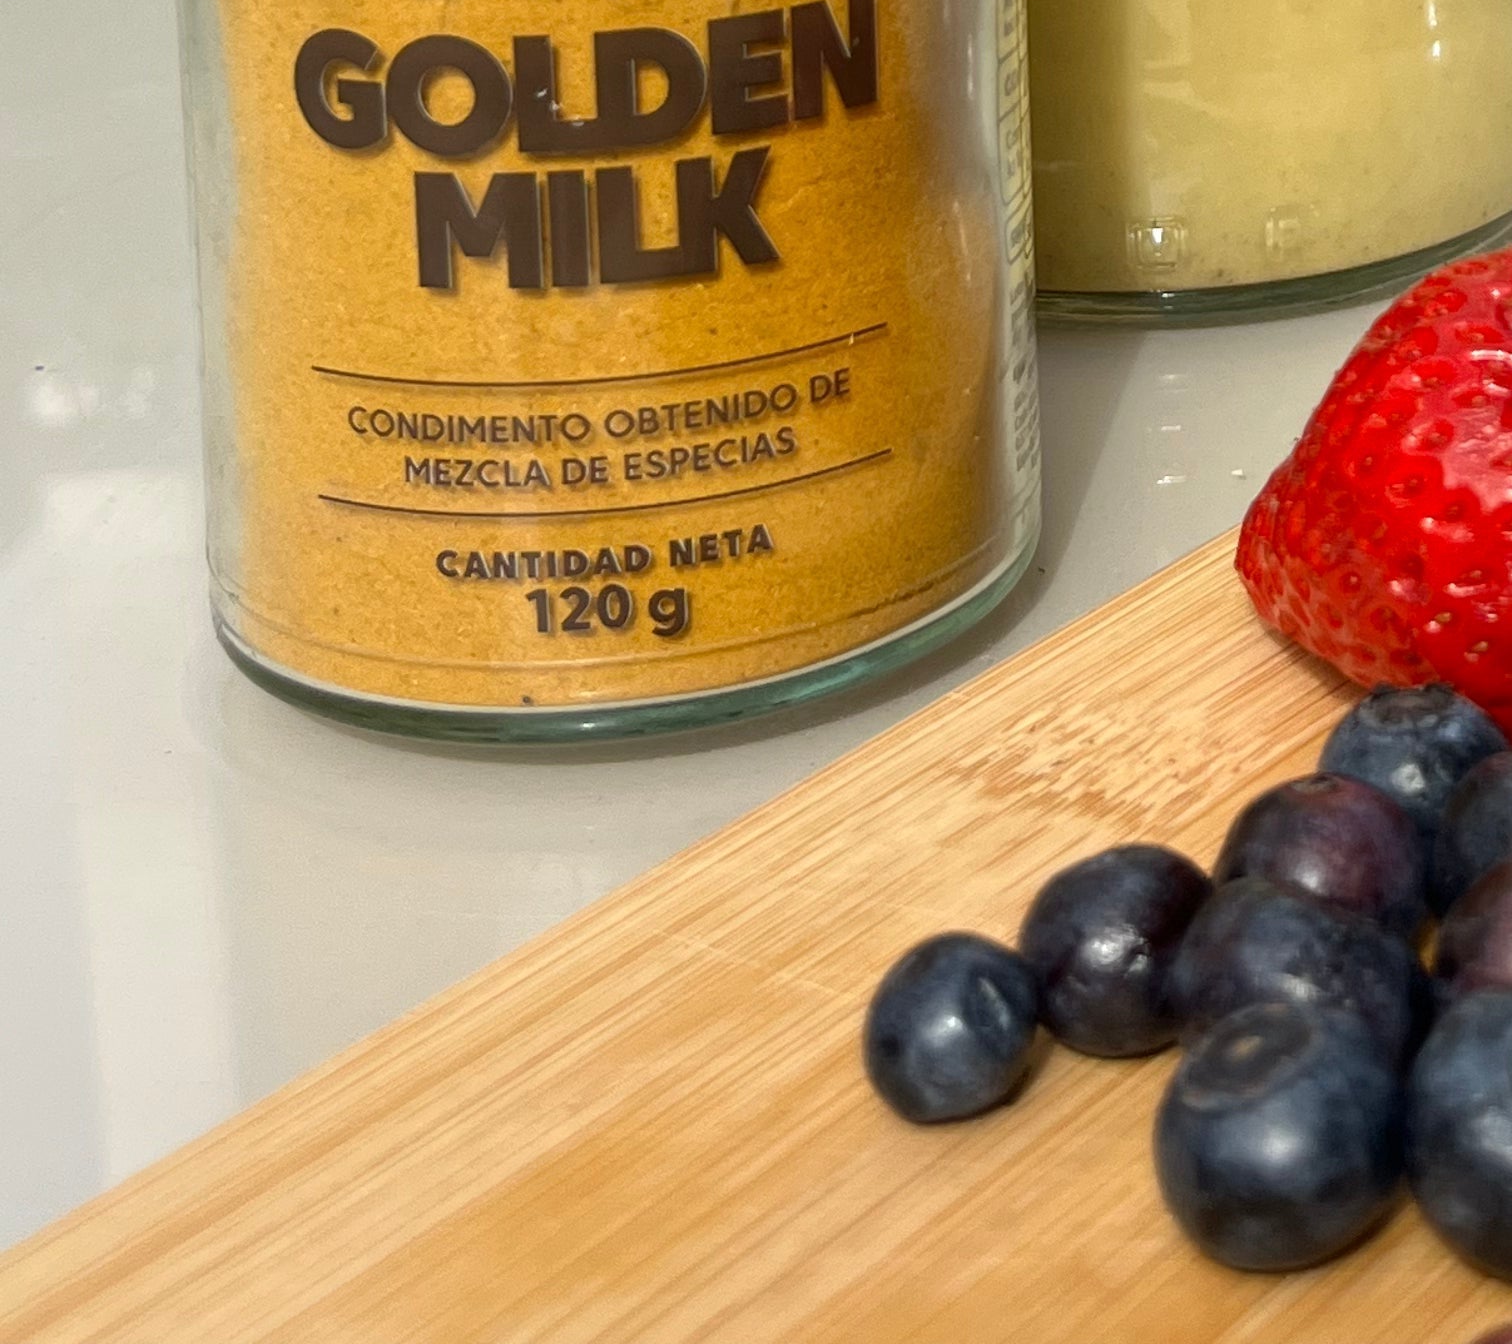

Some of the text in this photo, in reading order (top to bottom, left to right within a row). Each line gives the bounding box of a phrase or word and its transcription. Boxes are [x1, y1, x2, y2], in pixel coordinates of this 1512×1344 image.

[413, 145, 779, 289] MILK
[348, 367, 851, 444] CONDIMENTO OBTENIDO DE
[404, 426, 796, 487] MEZCLA DE ESPECIAS
[435, 523, 773, 579] CANTIDAD NETA
[525, 583, 688, 636] 120 g
